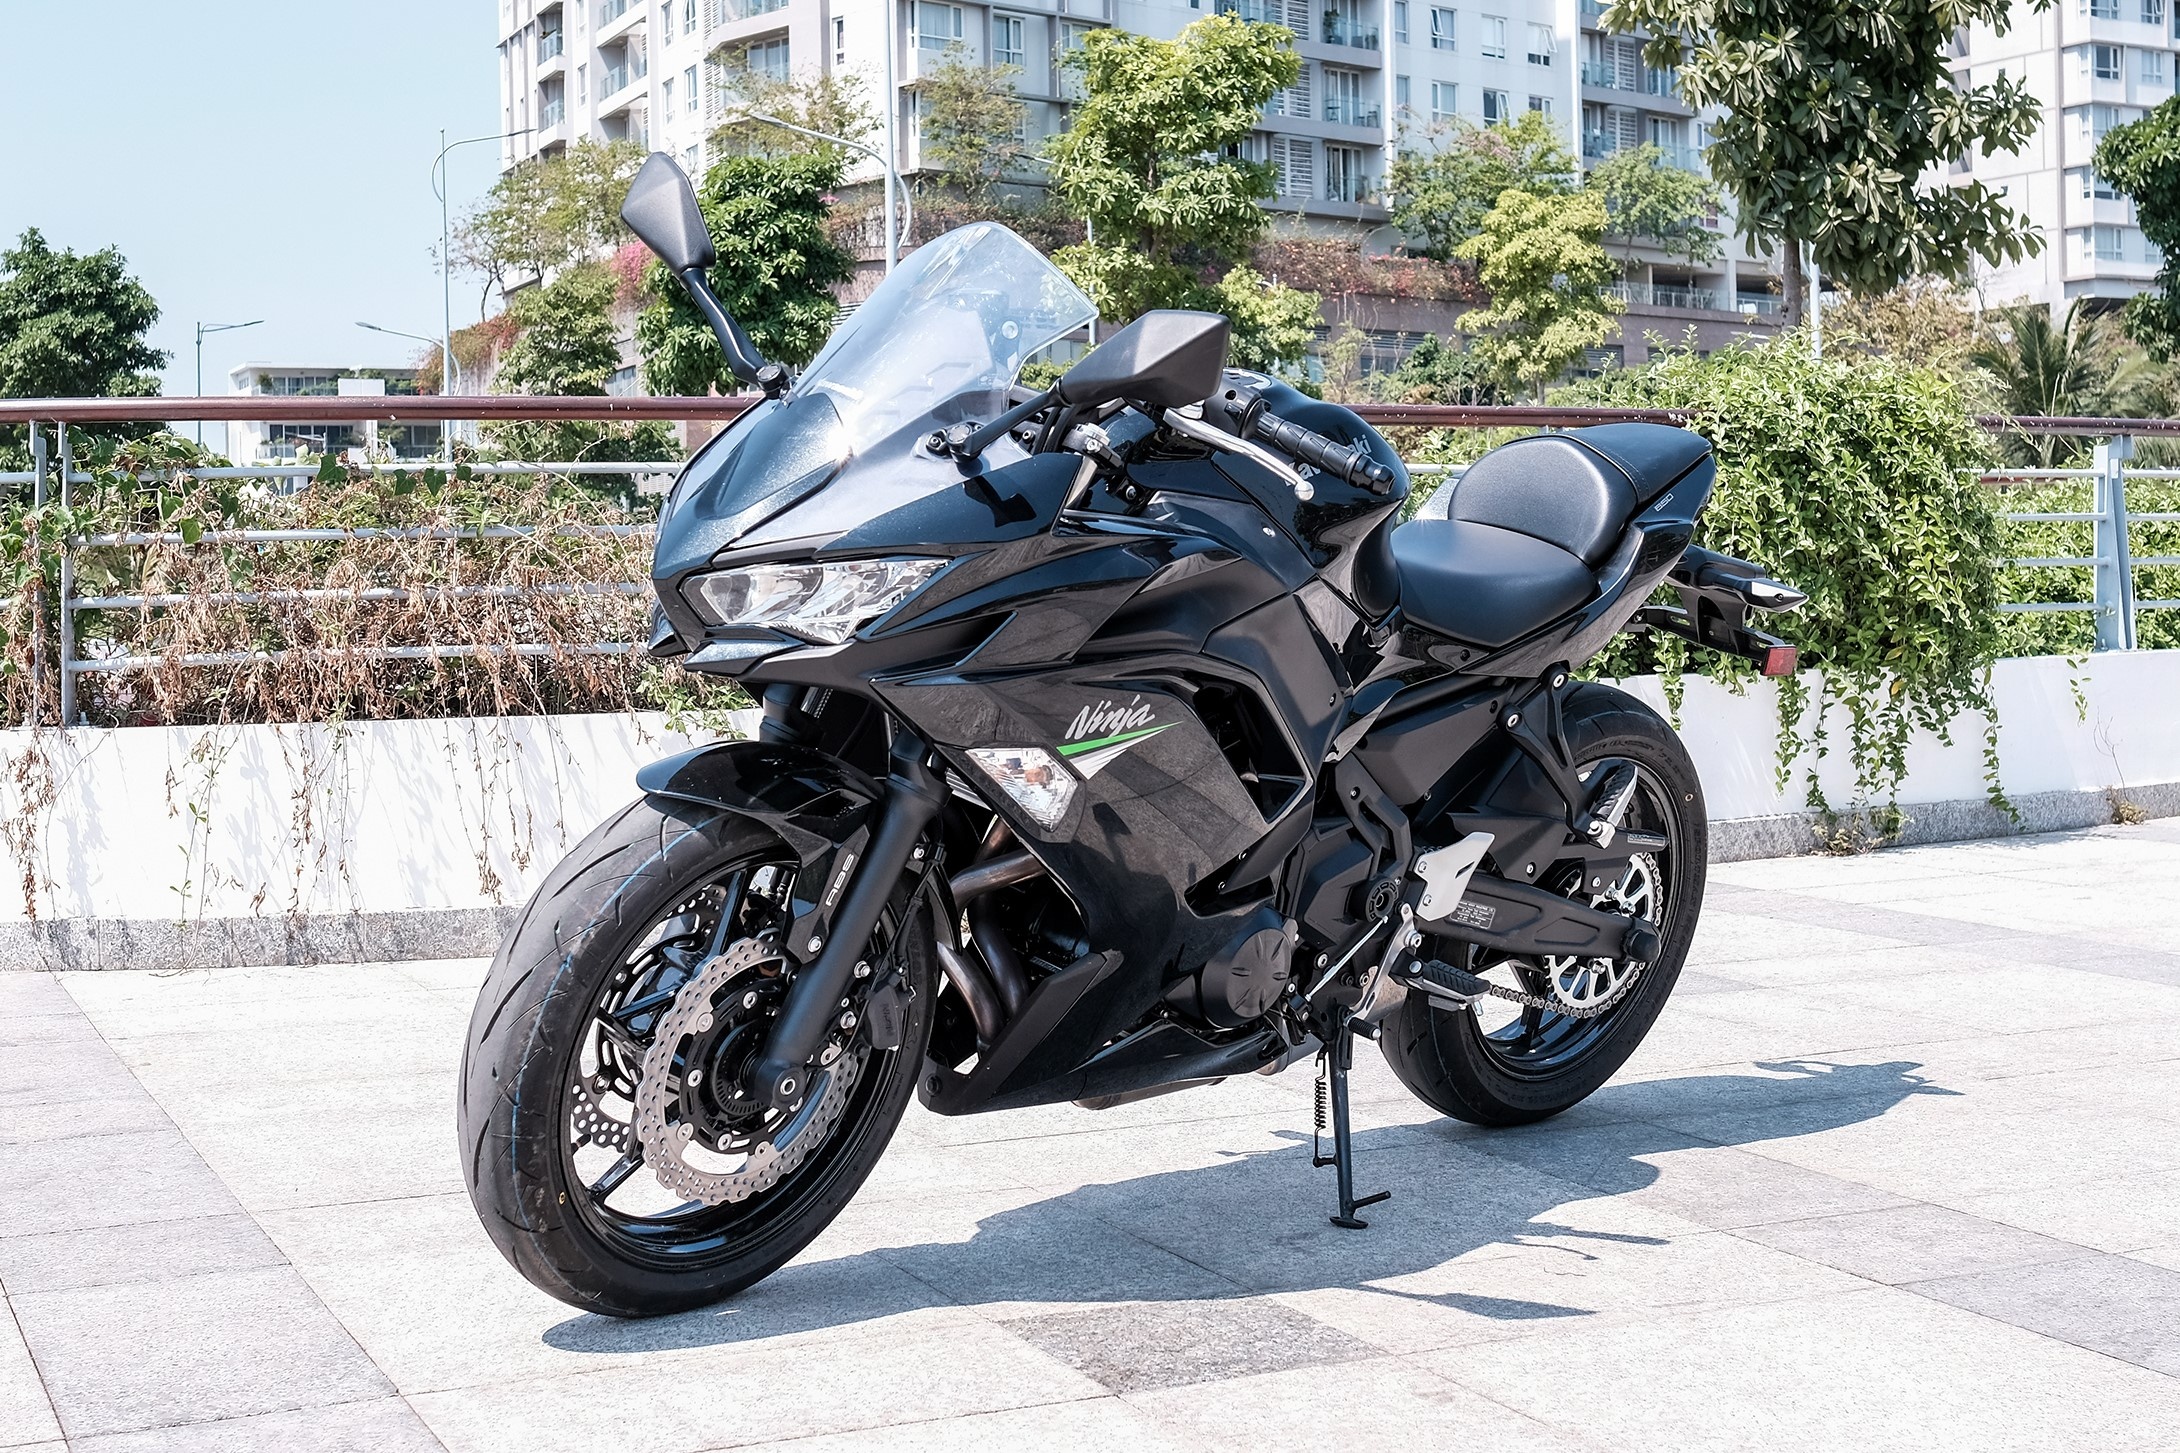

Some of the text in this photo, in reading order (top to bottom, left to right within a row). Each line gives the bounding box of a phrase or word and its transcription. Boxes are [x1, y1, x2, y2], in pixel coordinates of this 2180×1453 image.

[1654, 493, 1674, 512] 650
[1065, 694, 1155, 739] Ninja
[825, 853, 855, 906] ABS
